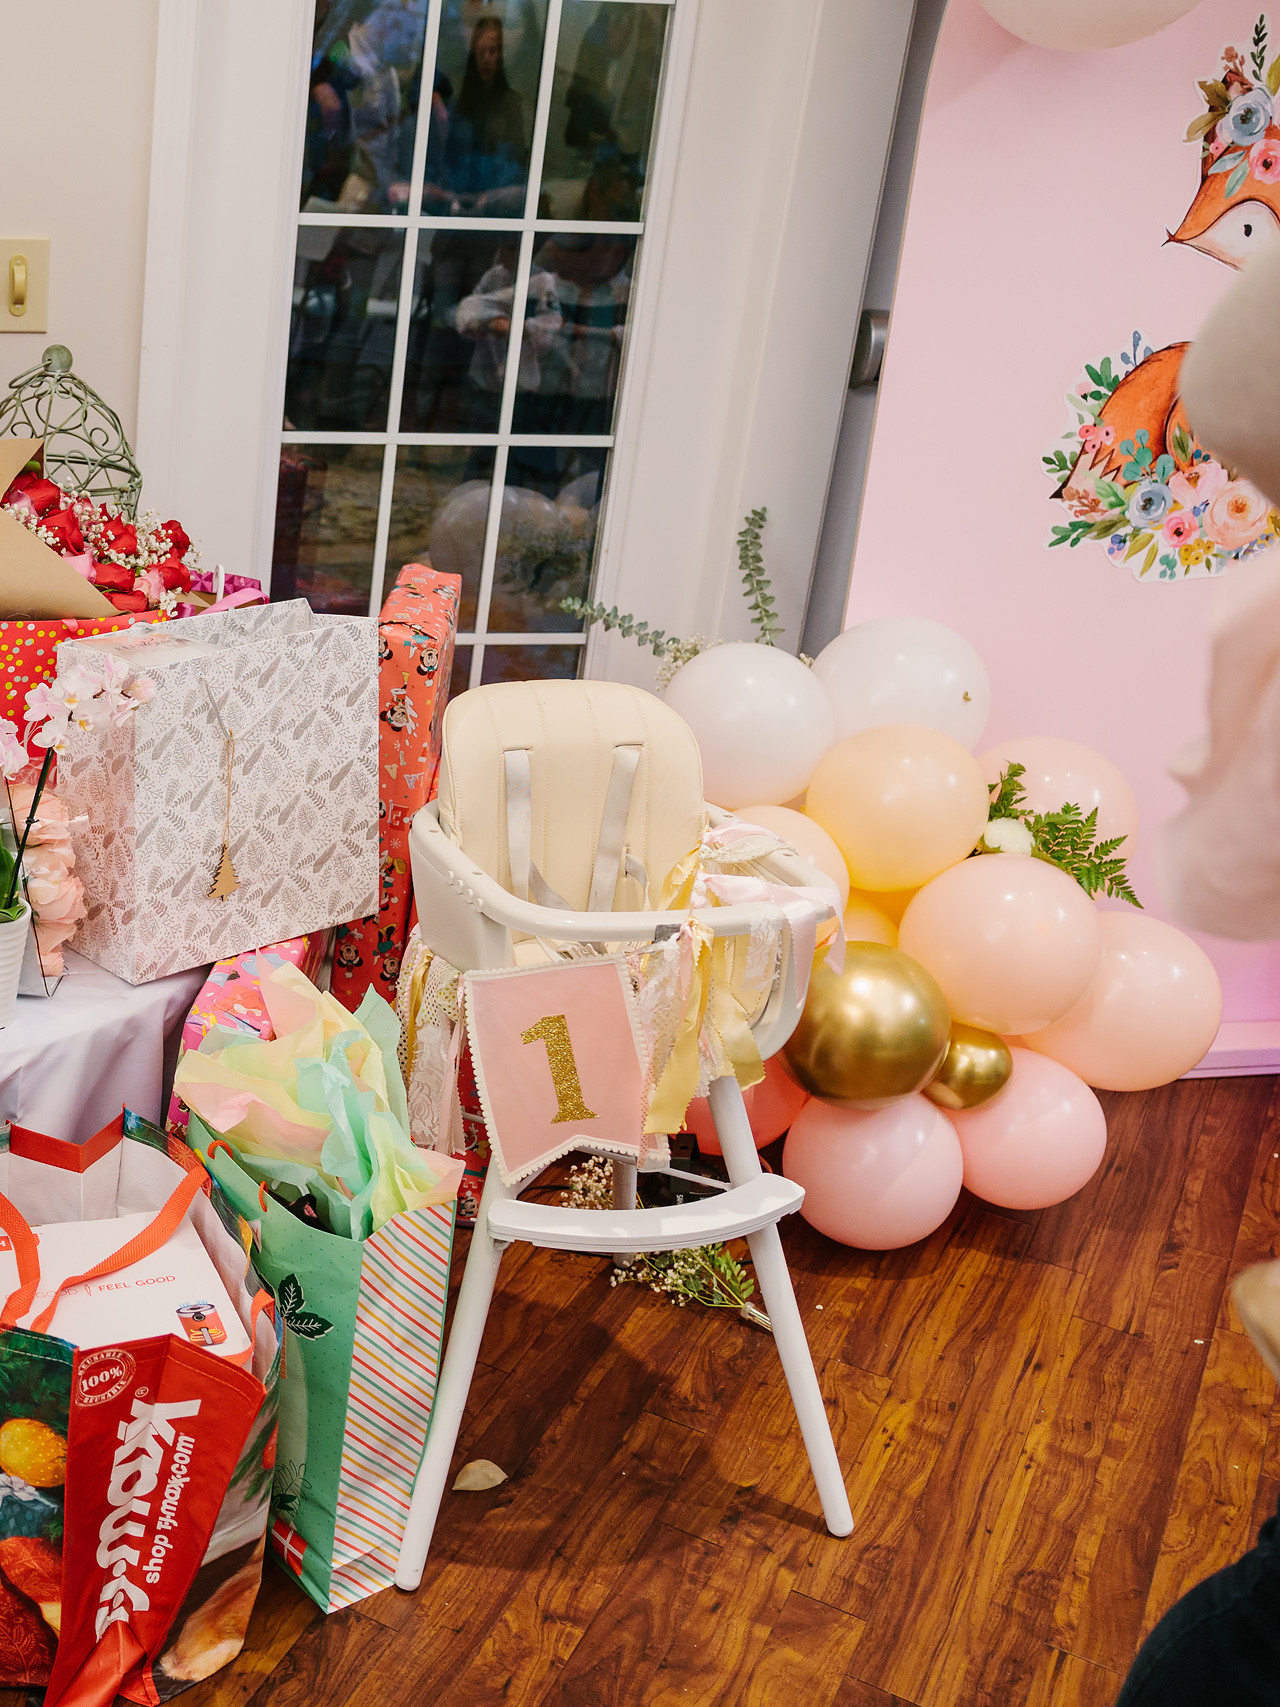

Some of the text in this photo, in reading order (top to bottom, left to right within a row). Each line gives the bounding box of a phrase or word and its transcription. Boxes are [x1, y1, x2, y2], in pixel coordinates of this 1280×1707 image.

[520, 1014, 600, 1124] 1
[98, 1281, 132, 1292] FEEL
[135, 1275, 176, 1287] GOOD
[81, 1365, 123, 1392] 100%
[142, 1533, 173, 1584] shop
